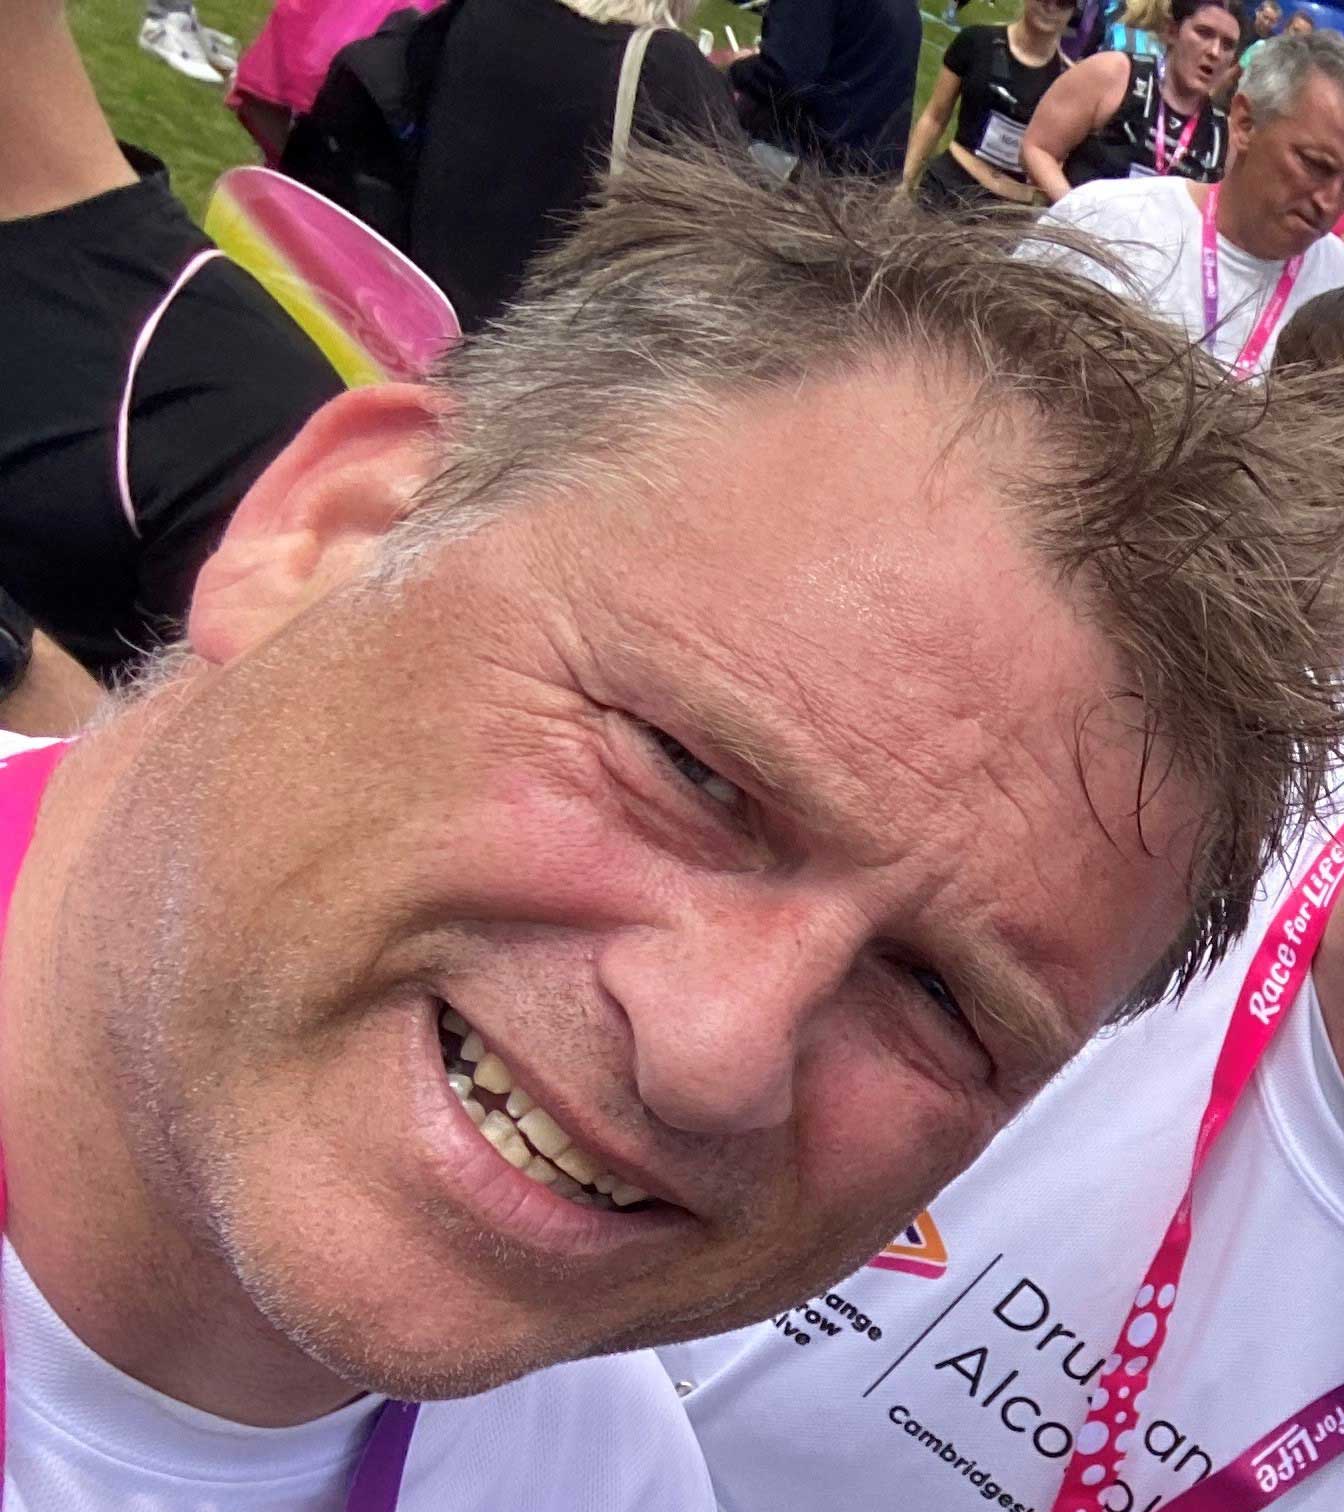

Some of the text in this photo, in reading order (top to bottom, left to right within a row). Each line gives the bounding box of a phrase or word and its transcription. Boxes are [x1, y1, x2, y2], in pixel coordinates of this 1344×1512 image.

[1250, 943, 1298, 1025] Race
[1284, 902, 1312, 945] for
[820, 1292, 883, 1341] ange
[992, 1277, 1106, 1406] Dru
[1253, 1426, 1318, 1493] Life
